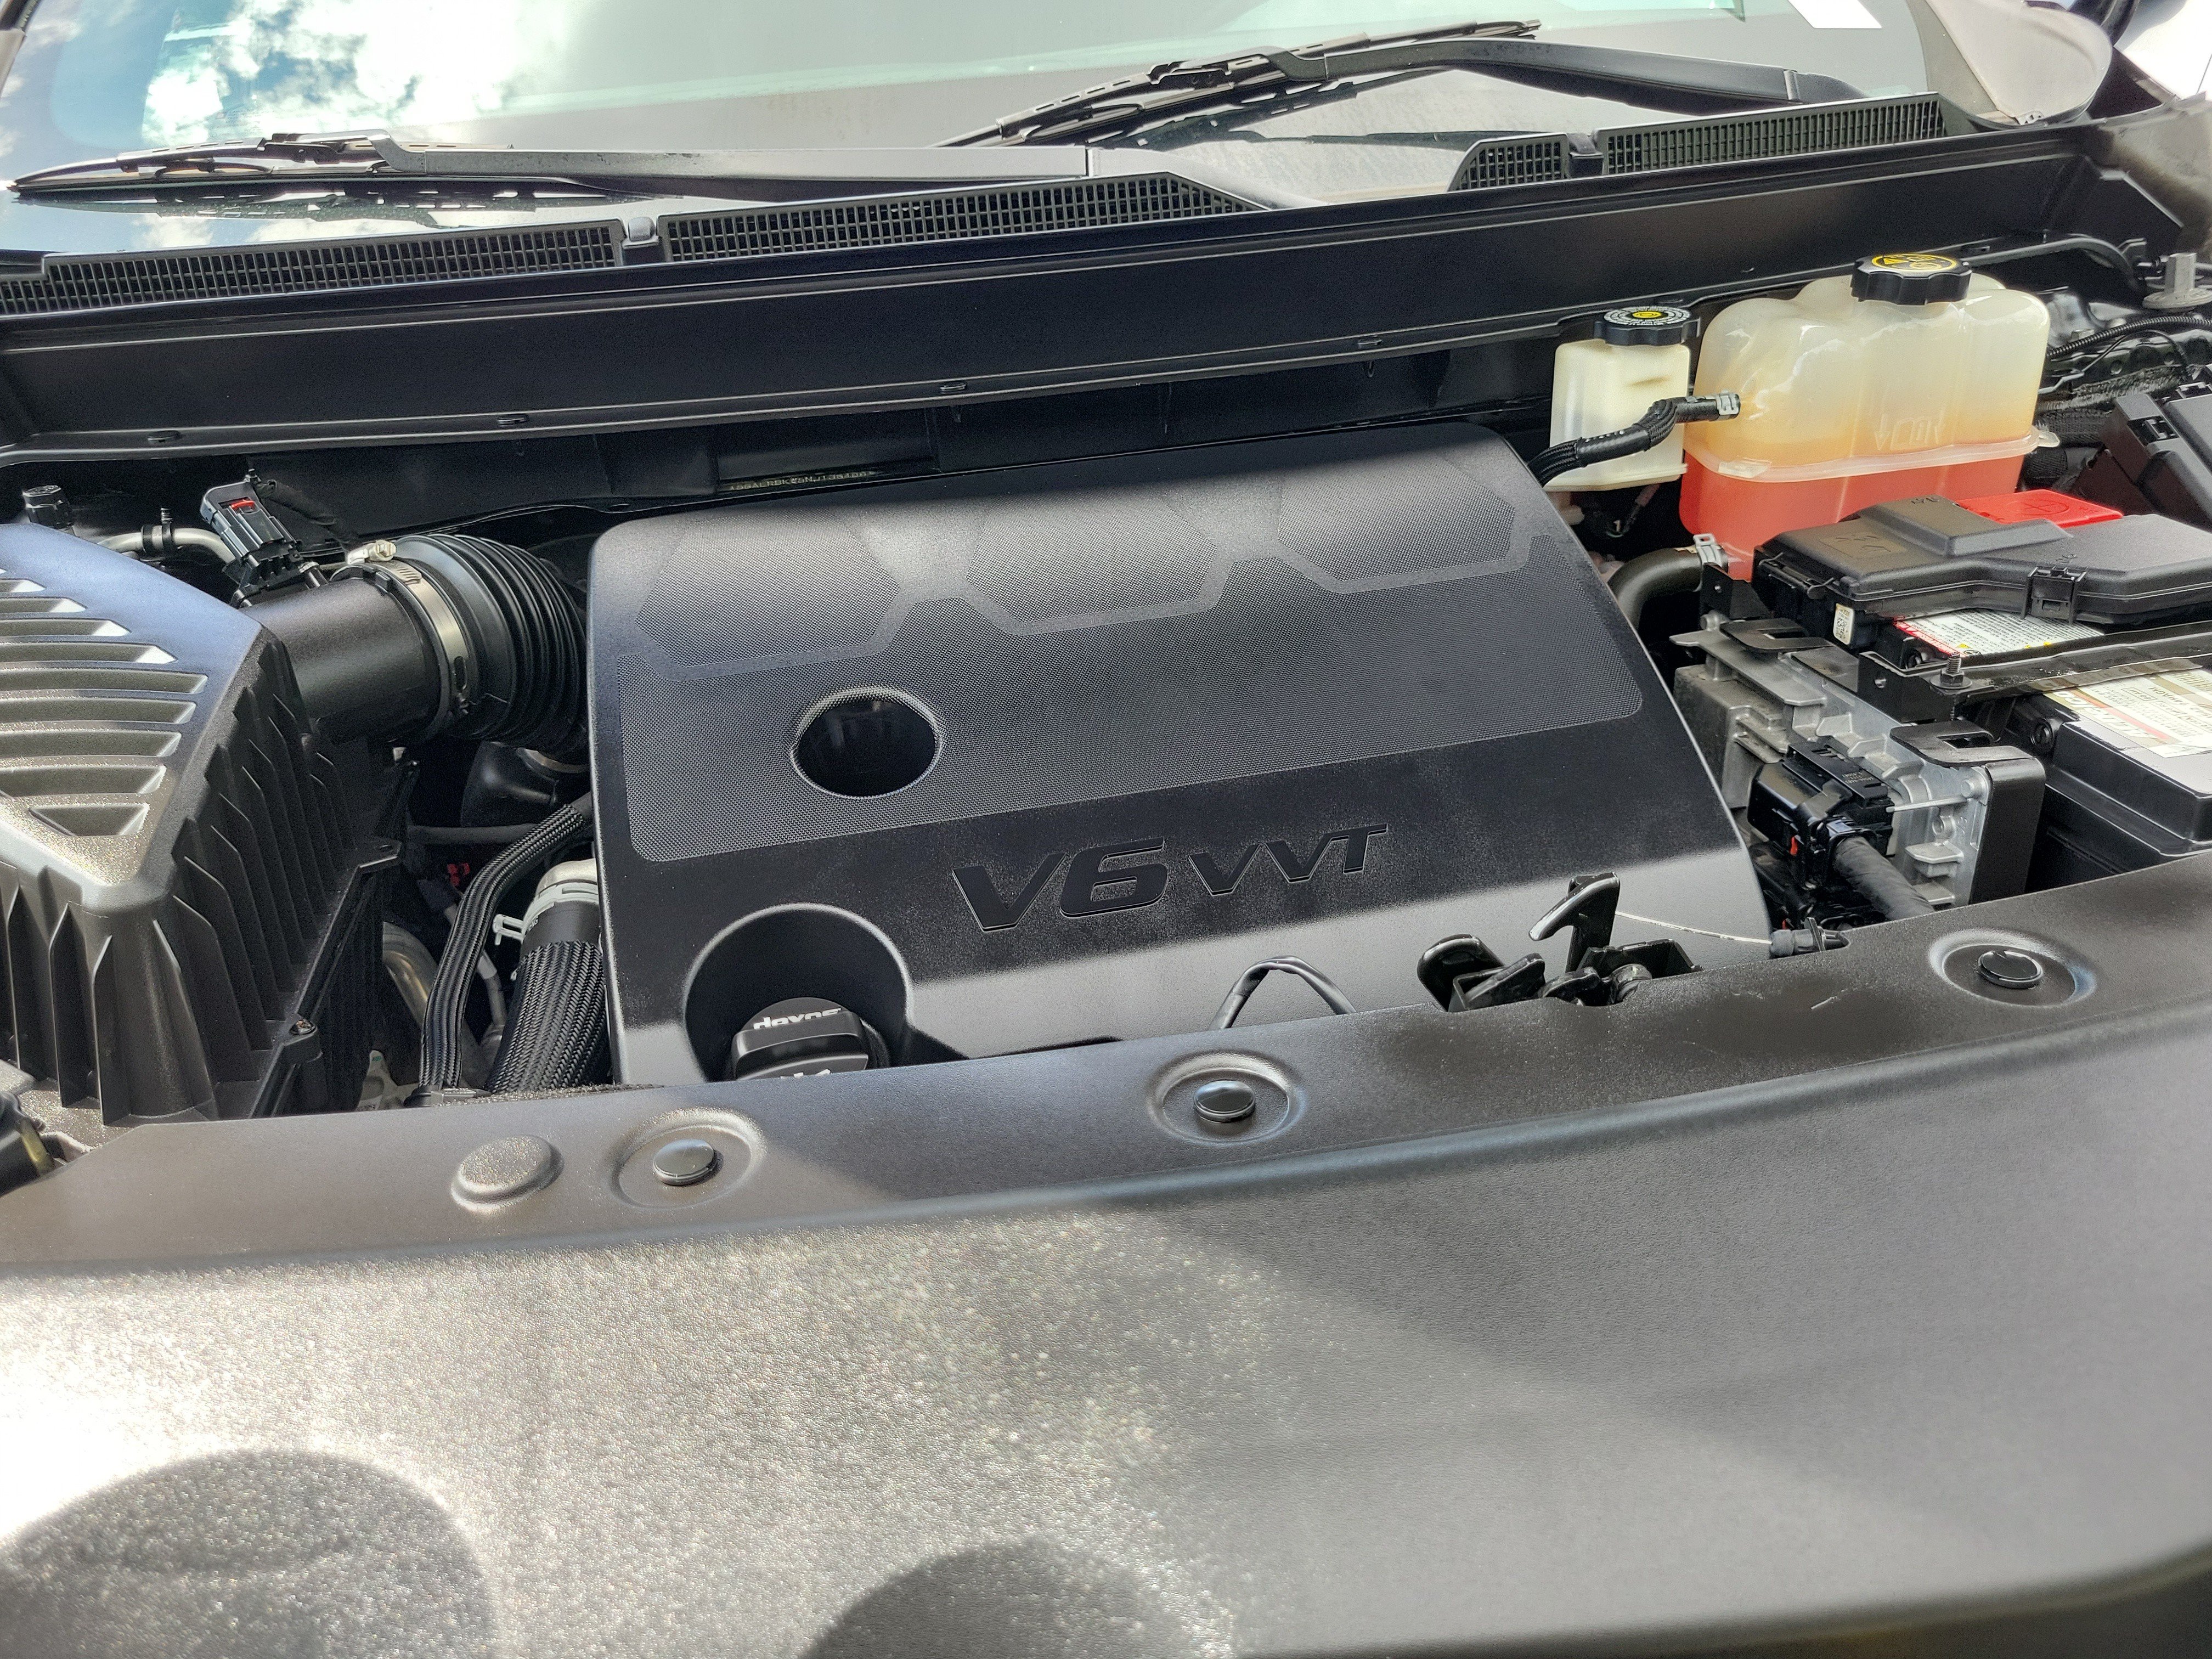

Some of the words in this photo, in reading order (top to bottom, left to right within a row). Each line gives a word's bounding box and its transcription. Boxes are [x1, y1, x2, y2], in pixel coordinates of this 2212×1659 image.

[2053, 691, 2158, 738] ACDelco
[952, 837, 1169, 933] V6
[1188, 823, 1389, 896] VVT
